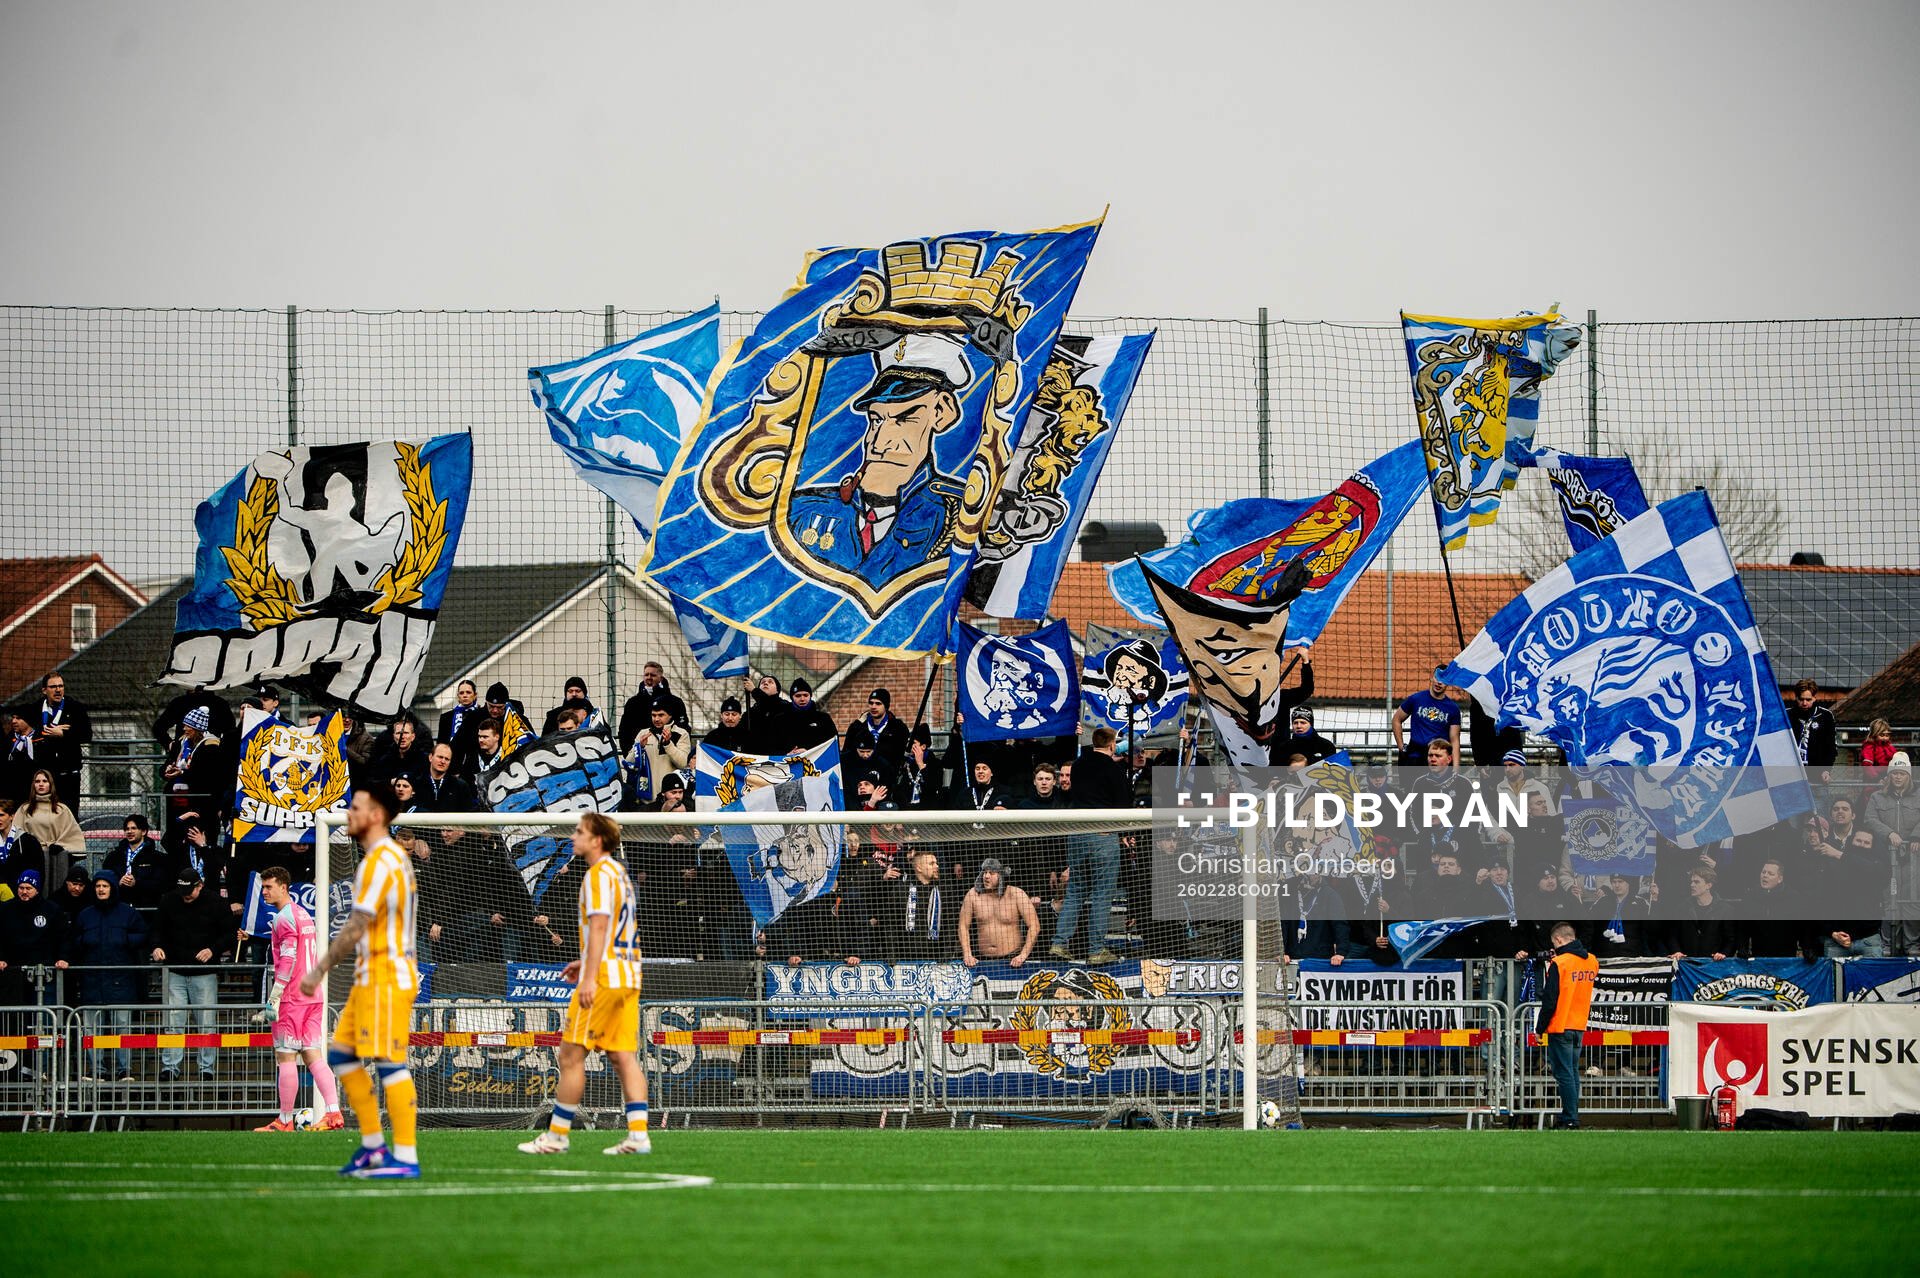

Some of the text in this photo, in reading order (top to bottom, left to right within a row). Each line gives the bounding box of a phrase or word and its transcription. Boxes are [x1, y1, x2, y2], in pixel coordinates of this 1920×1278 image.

[767, 964, 919, 996] YNGRE
[1305, 978, 1405, 1002] SYMPATI
[1412, 975, 1456, 1002] FÖR
[1626, 976, 1640, 984] live
[1641, 975, 1668, 984] forever
[1591, 987, 1668, 1006] mpus
[1306, 1009, 1331, 1030] DE
[1781, 1070, 1866, 1097] SPEL
